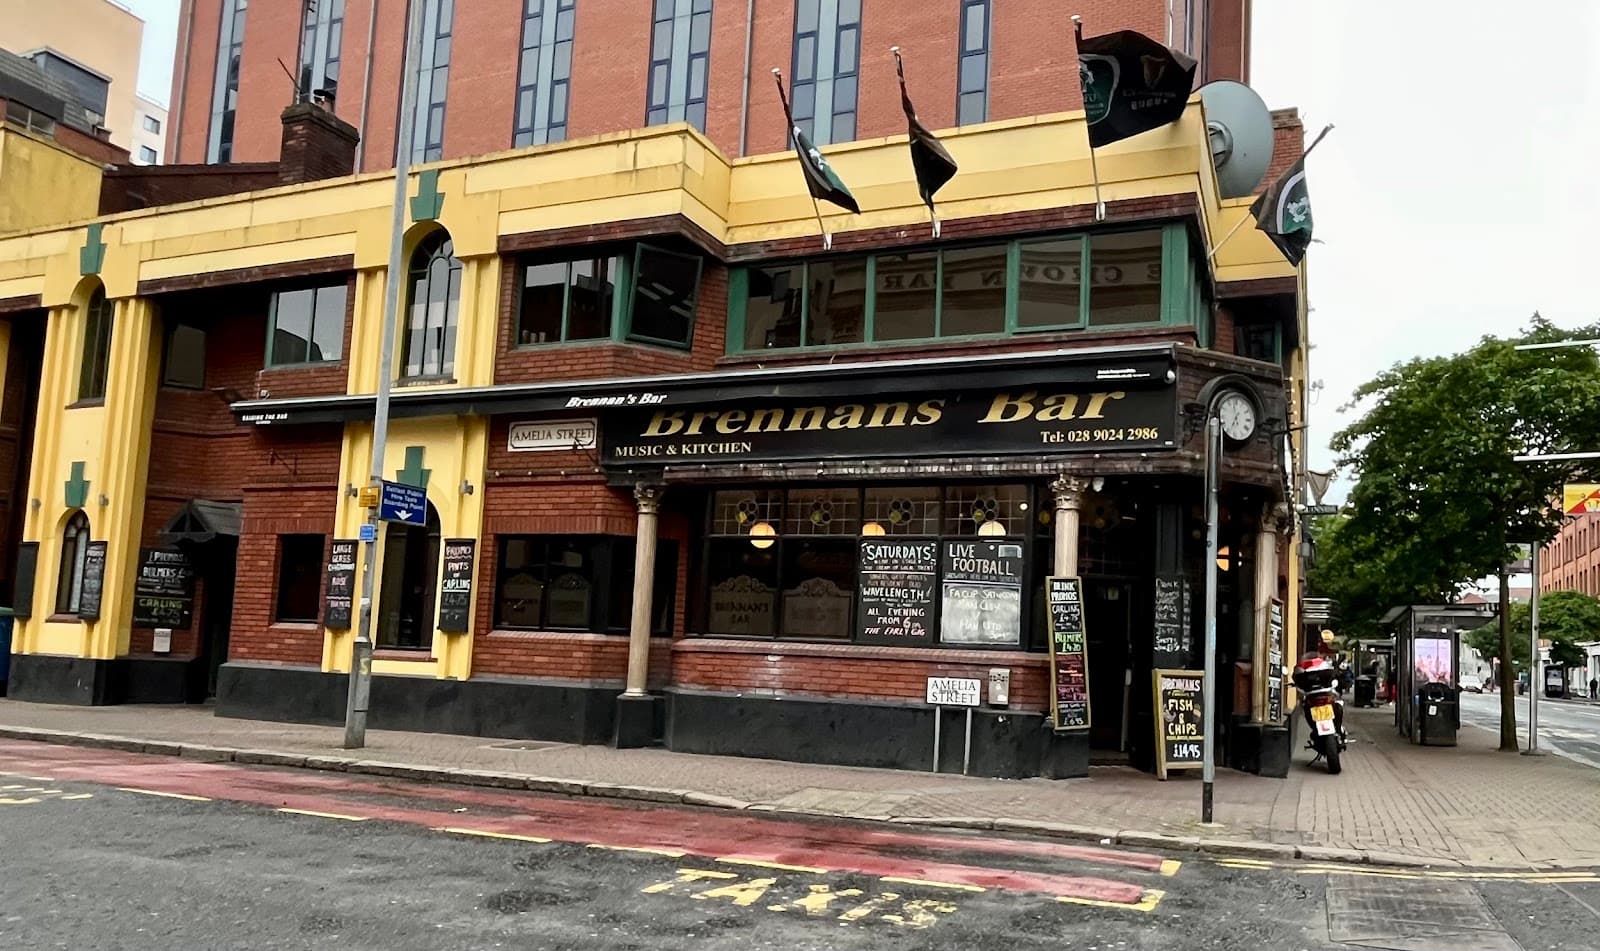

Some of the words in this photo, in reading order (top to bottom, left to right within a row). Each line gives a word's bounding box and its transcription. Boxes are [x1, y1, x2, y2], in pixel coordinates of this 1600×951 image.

[565, 394, 637, 408] Brennan's
[638, 393, 667, 404] Bar
[977, 391, 1126, 423] Bar
[514, 429, 552, 441] AMELIA
[556, 428, 593, 440] STREET
[1041, 430, 1065, 443] Tel:
[1067, 430, 1090, 442] 028
[1093, 429, 1124, 442] 9024
[1127, 428, 1159, 440] 2986
[615, 445, 662, 457] MUSIC
[666, 444, 677, 455] &
[681, 442, 752, 454] KITCHEN
[446, 546, 472, 556] PROMO
[866, 545, 931, 560] SATURDAYS
[949, 543, 976, 558] LIVE
[448, 562, 470, 572] PINTS
[952, 558, 1014, 576] FOOTBALL
[442, 579, 471, 590] CARLING
[949, 588, 960, 599] FA
[961, 589, 978, 598] CUP
[1051, 592, 1078, 601] PROMOS
[867, 607, 880, 616] ALL
[888, 608, 925, 616] EVENING
[1052, 604, 1080, 615] CARLING
[877, 616, 900, 624] FROM
[931, 680, 976, 691] AMELIA
[931, 691, 976, 704] STREET
[1168, 699, 1193, 711] FISH
[1178, 713, 1184, 723] &
[1168, 723, 1197, 735] CHIPS
